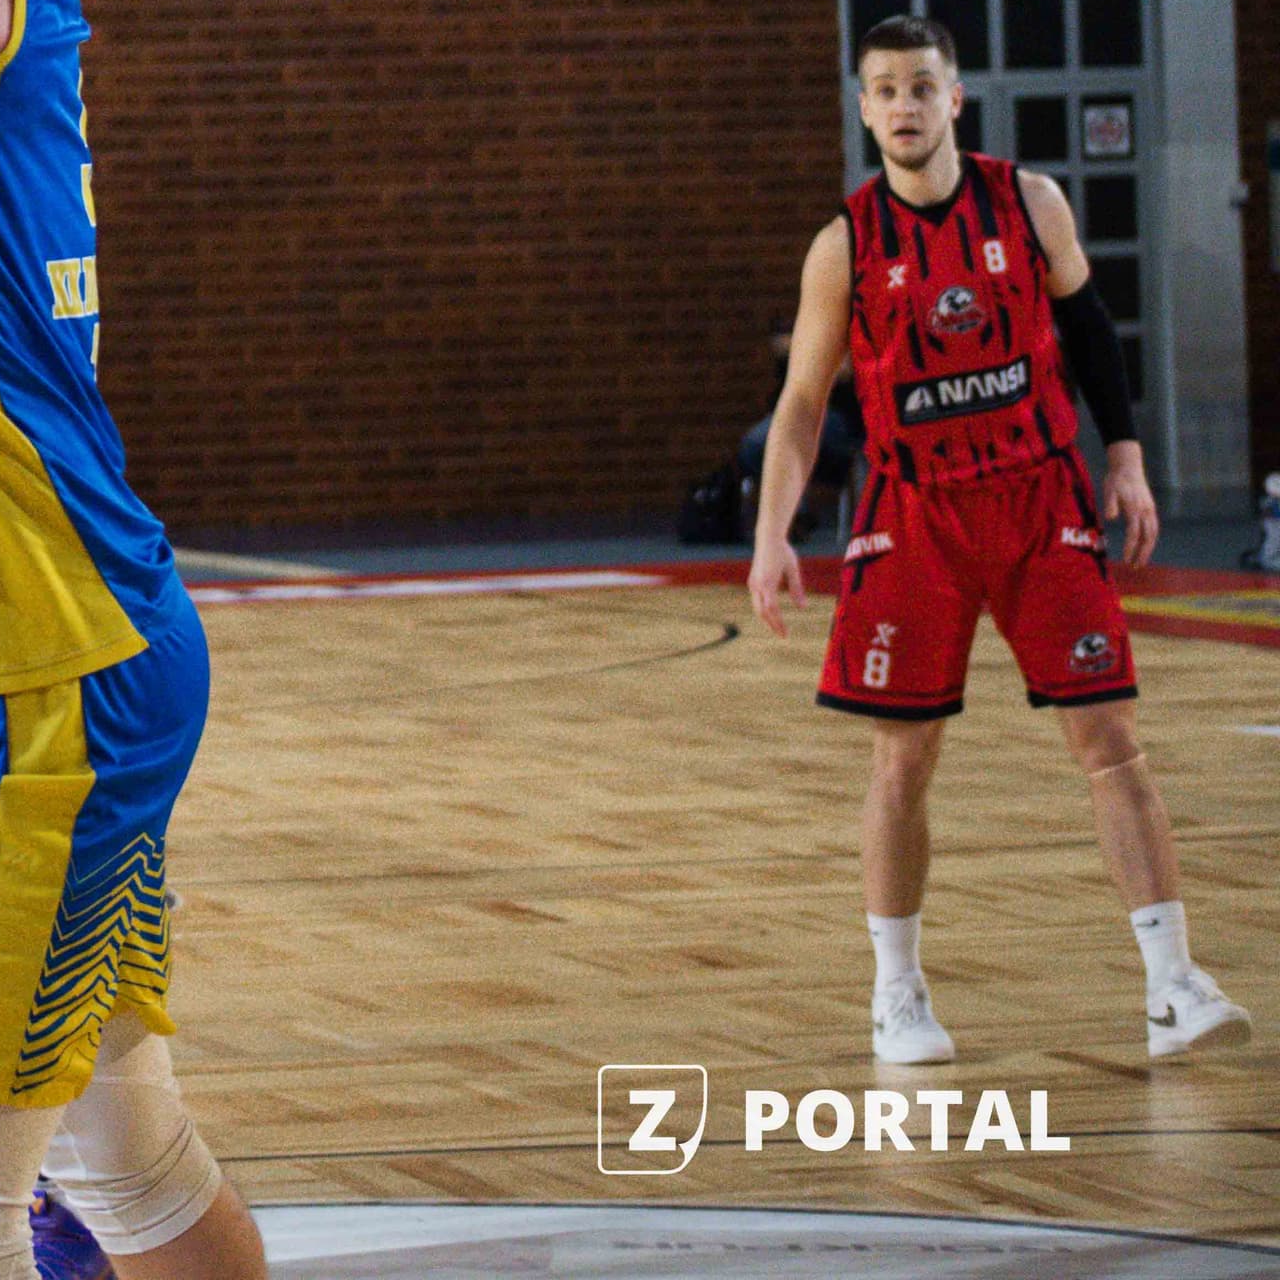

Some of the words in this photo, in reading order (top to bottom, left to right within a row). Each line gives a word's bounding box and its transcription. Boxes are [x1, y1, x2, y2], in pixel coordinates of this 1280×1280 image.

[983, 239, 1007, 274] 8
[937, 360, 1028, 407] NANSI
[863, 649, 890, 688] 8
